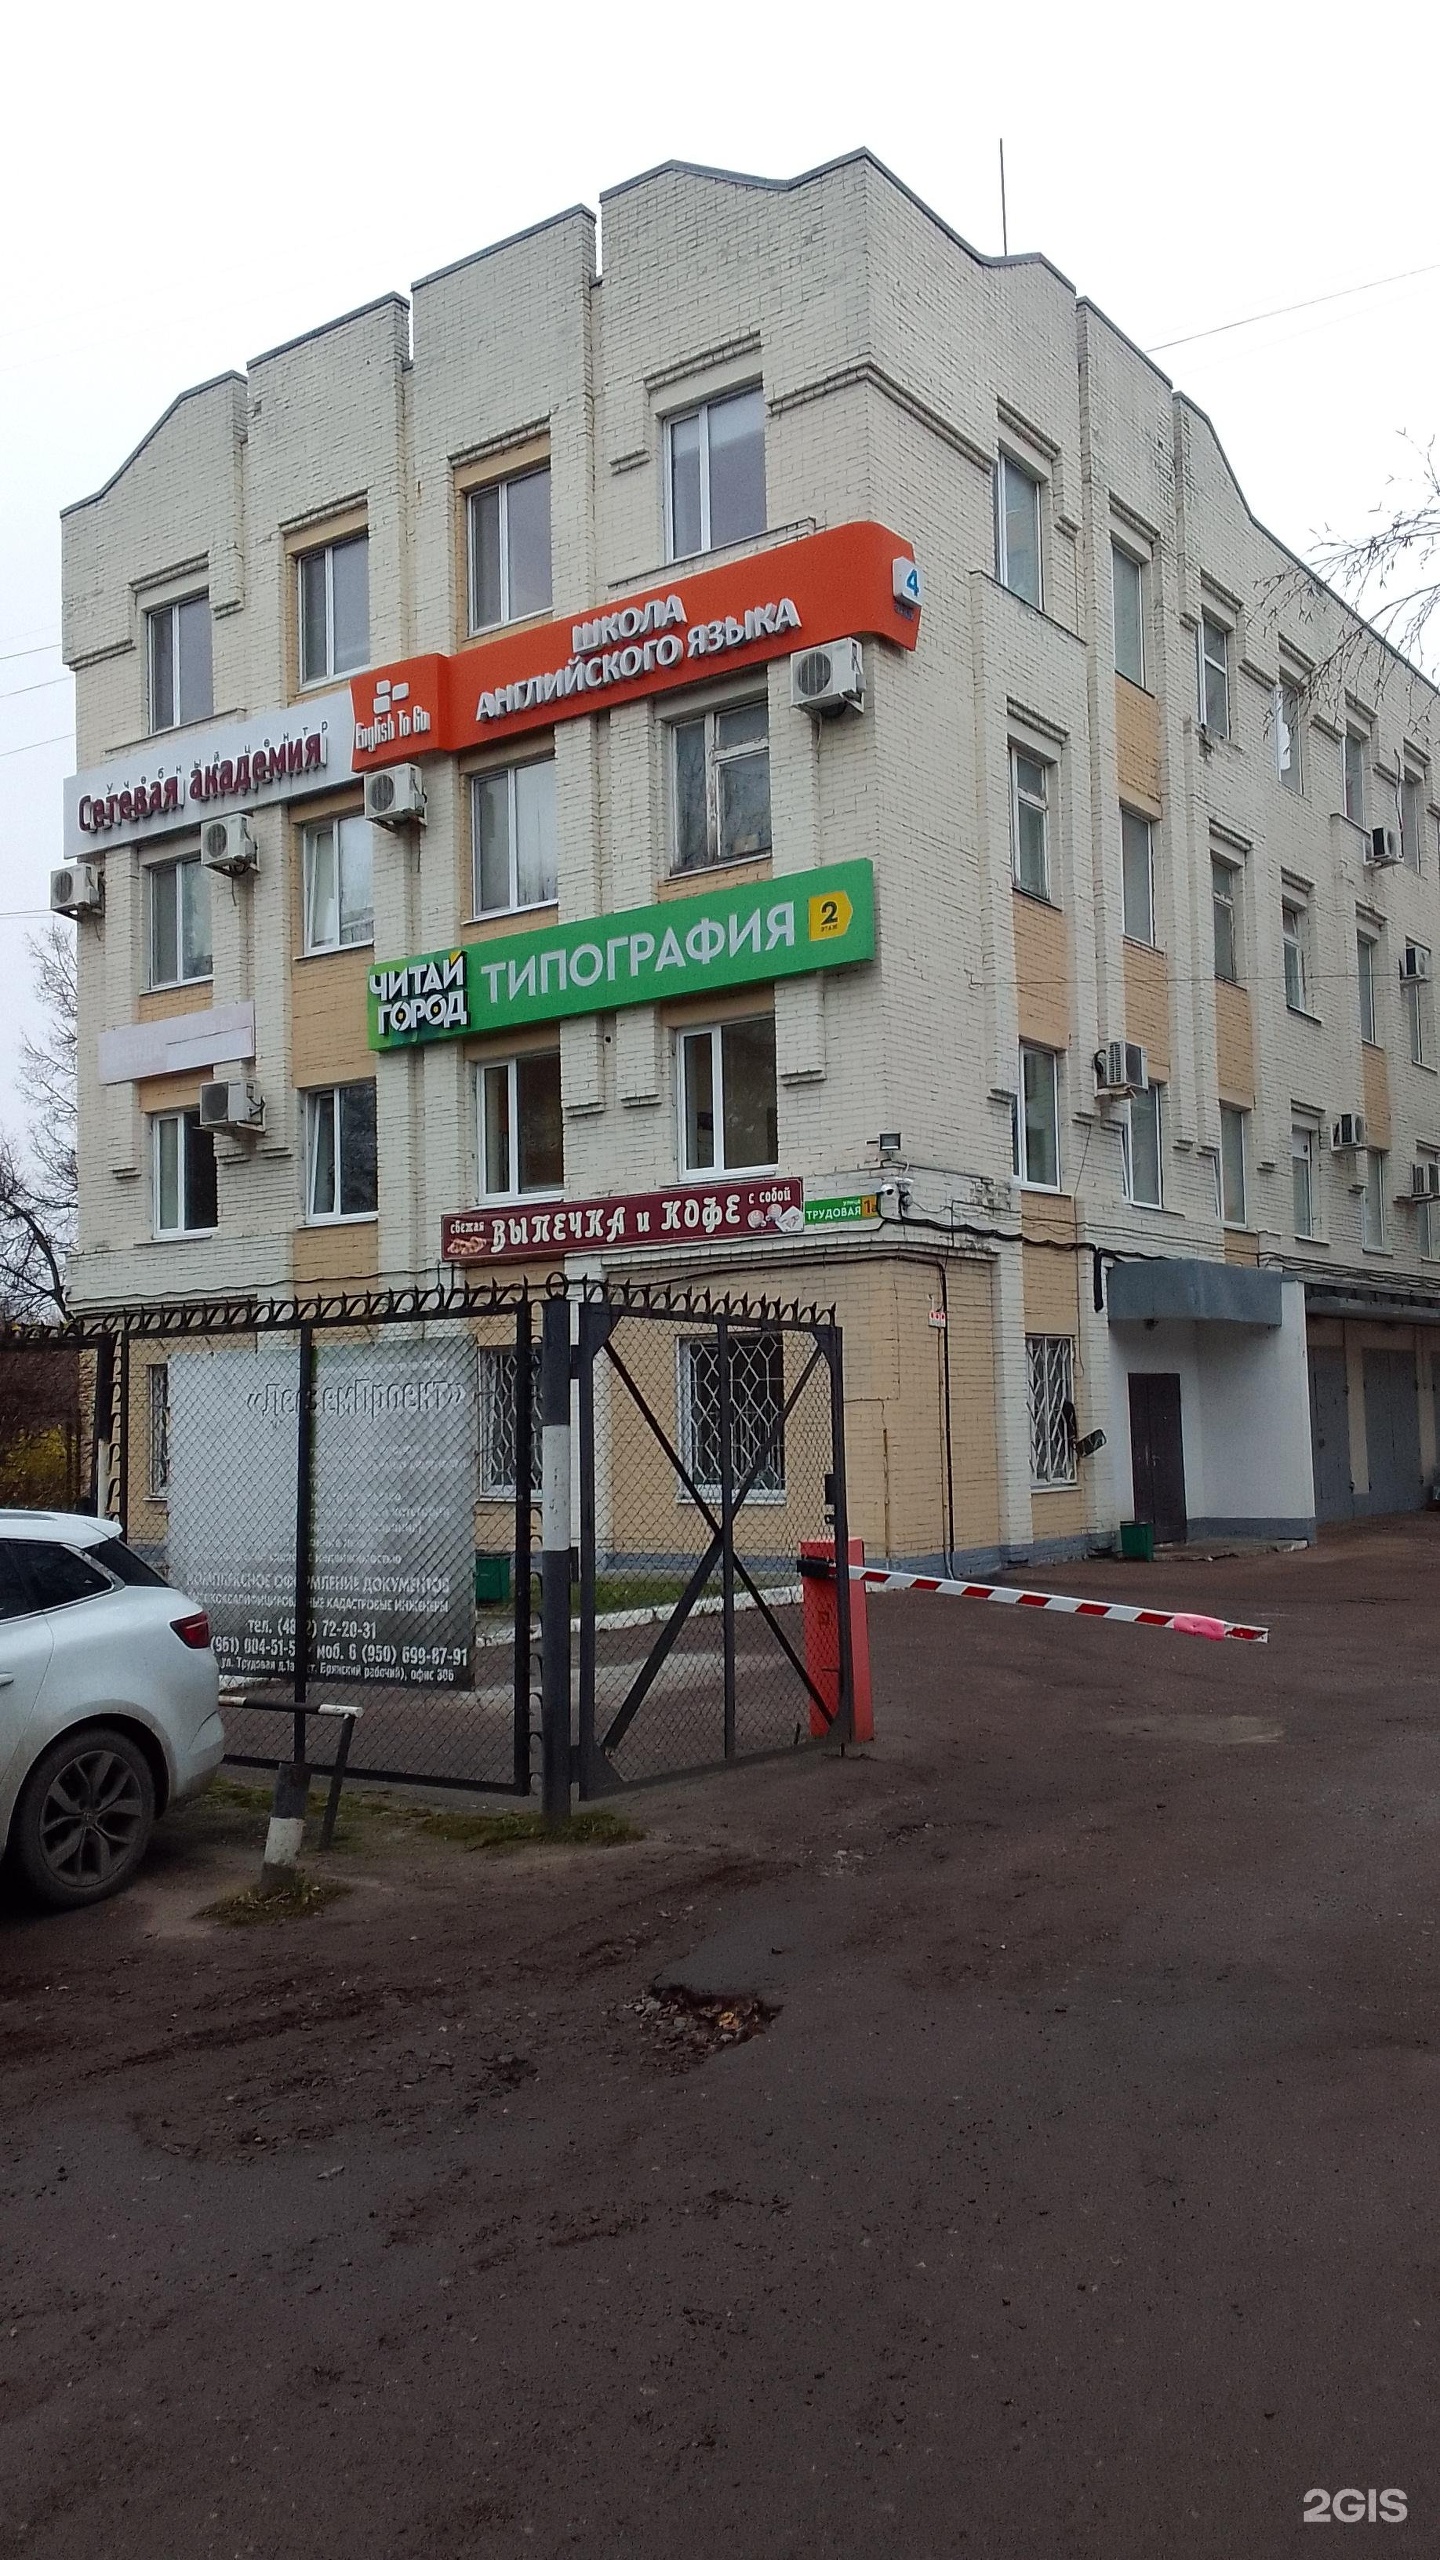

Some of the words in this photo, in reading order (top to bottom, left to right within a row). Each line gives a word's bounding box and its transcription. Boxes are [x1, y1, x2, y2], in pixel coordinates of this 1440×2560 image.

[906, 569, 919, 597] 4
[573, 595, 687, 653] ШКОЛА
[476, 635, 683, 721] АНГЛИЙСКОГО
[687, 598, 802, 658] ЯЗЫКА
[244, 721, 328, 754] центр
[355, 713, 395, 753] English
[397, 710, 411, 737] To
[79, 775, 182, 831] Сетевая
[189, 732, 324, 800] академия
[821, 901, 838, 925] 2
[481, 901, 795, 1003] ТИПОГРАФИЯ
[370, 951, 464, 1001] ЧИТАЙ
[378, 990, 467, 1034] ГОРОД
[450, 1220, 485, 1234] свежая
[491, 1207, 625, 1253] ВЫПЕЧКА
[637, 1211, 650, 1232] и
[661, 1194, 740, 1233] КОФЕ
[748, 1192, 755, 1204] с
[760, 1187, 791, 1203] собой
[806, 1206, 861, 1220] ТРУДОВАЯ
[363, 1575, 450, 1594] ДОКУМЕНТОВ
[248, 1619, 273, 1634] тел.
[322, 1620, 376, 1640] 72-20-31
[317, 1643, 344, 1659] моб.
[362, 1644, 397, 1665] (950)
[402, 1646, 468, 1667] 699-87-91
[410, 1668, 434, 1682] офис
